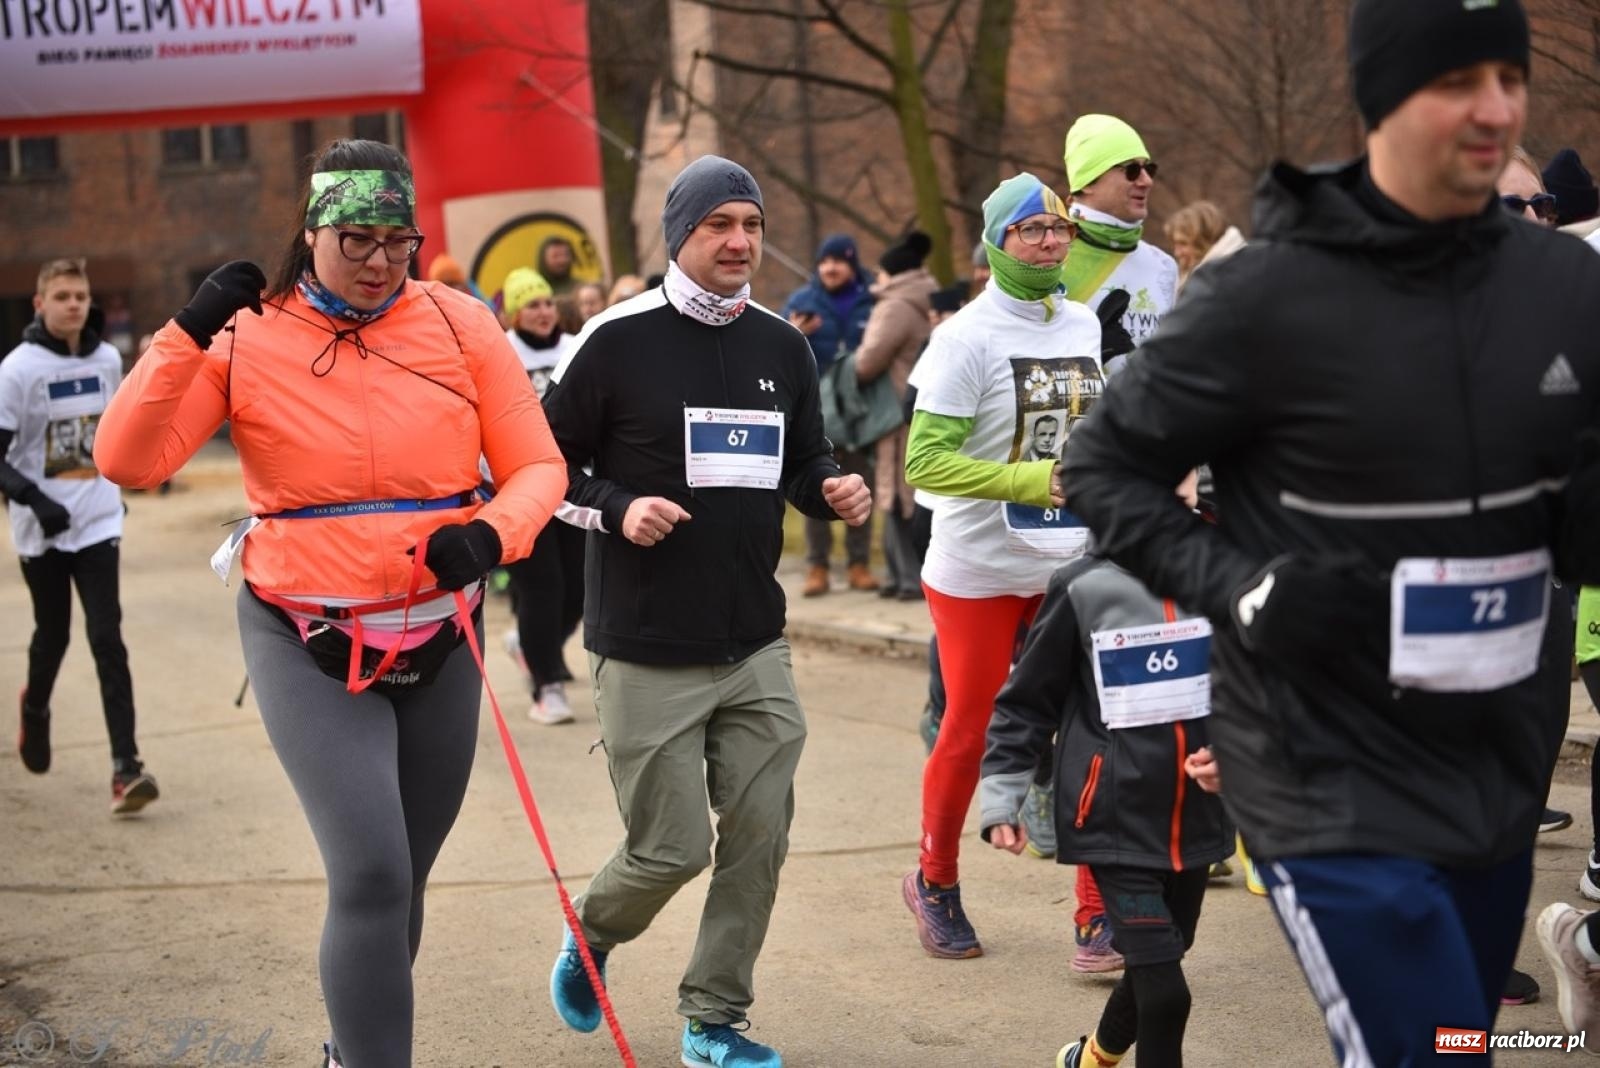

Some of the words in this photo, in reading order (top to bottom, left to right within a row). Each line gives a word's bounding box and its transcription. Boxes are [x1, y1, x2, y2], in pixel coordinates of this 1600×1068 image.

[727, 429, 749, 447] 67
[1043, 508, 1060, 521] 61
[1471, 588, 1507, 624] 72
[1146, 649, 1178, 673] 66
